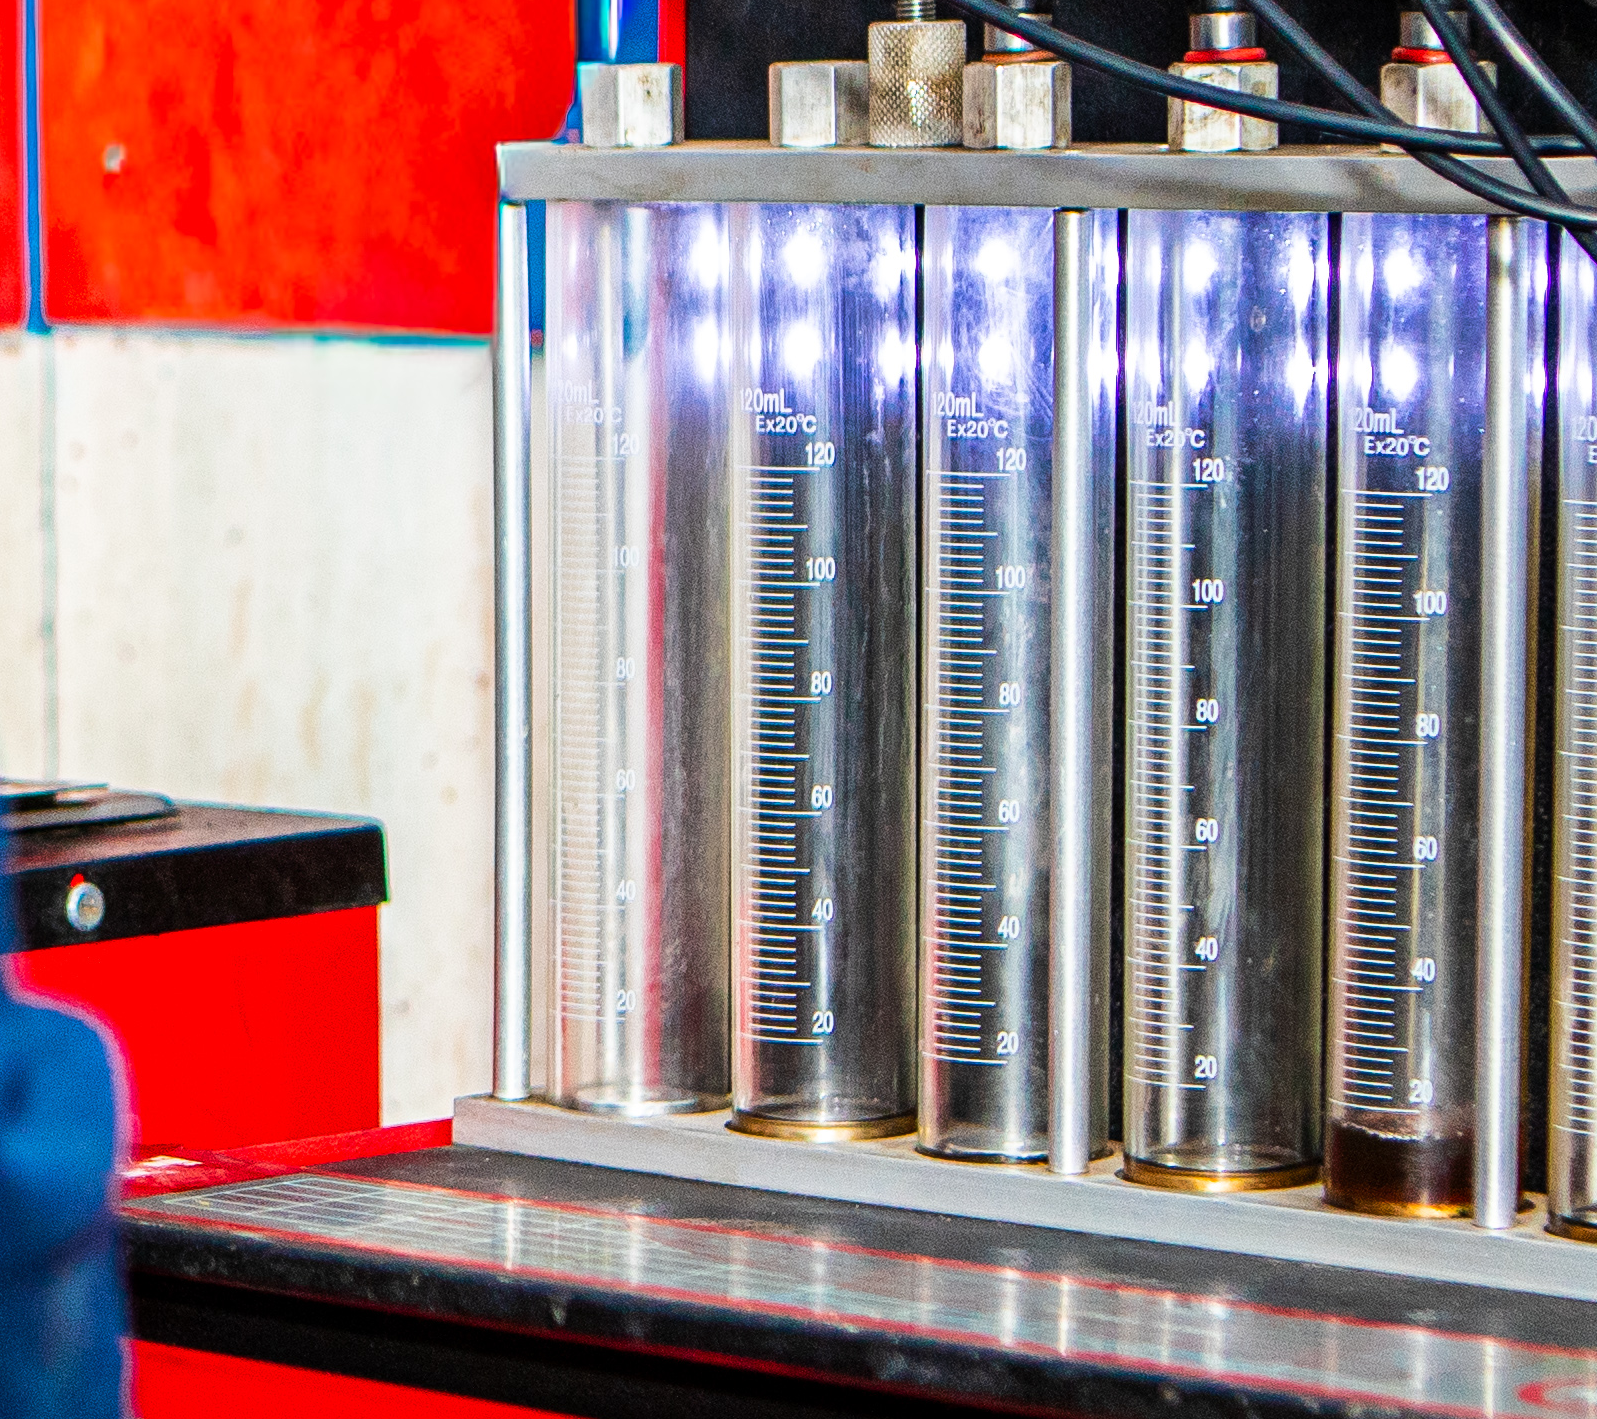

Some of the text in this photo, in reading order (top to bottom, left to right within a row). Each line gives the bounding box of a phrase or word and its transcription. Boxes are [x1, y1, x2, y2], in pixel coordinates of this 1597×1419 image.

[740, 387, 793, 413] 120mL
[932, 391, 984, 417] 120mL
[612, 433, 640, 456] 120
[805, 441, 836, 466] 120
[996, 447, 1027, 471] 120
[1193, 458, 1224, 483] 120
[1415, 467, 1450, 491] 120
[612, 546, 640, 567] 100
[805, 557, 836, 580] 100
[995, 565, 1026, 589] 100
[1192, 579, 1223, 603] 100
[1413, 592, 1447, 616] 100
[616, 658, 635, 679] 80
[811, 671, 833, 695] 80
[999, 682, 1021, 706] 80
[1196, 699, 1220, 722] 80
[1415, 713, 1440, 738] 80
[616, 770, 635, 791] 60
[811, 785, 834, 810] 60
[998, 799, 1020, 823] 60
[1195, 819, 1219, 842] 60
[1413, 836, 1438, 861] 60
[616, 880, 636, 900] 40
[811, 899, 834, 922] 40
[997, 915, 1020, 938] 40
[1195, 938, 1219, 961] 40
[1411, 958, 1436, 982] 40
[616, 991, 636, 1011] 20
[812, 1011, 834, 1034] 20
[996, 1032, 1019, 1055] 20
[1194, 1056, 1218, 1079] 20
[1409, 1080, 1433, 1104] 20
